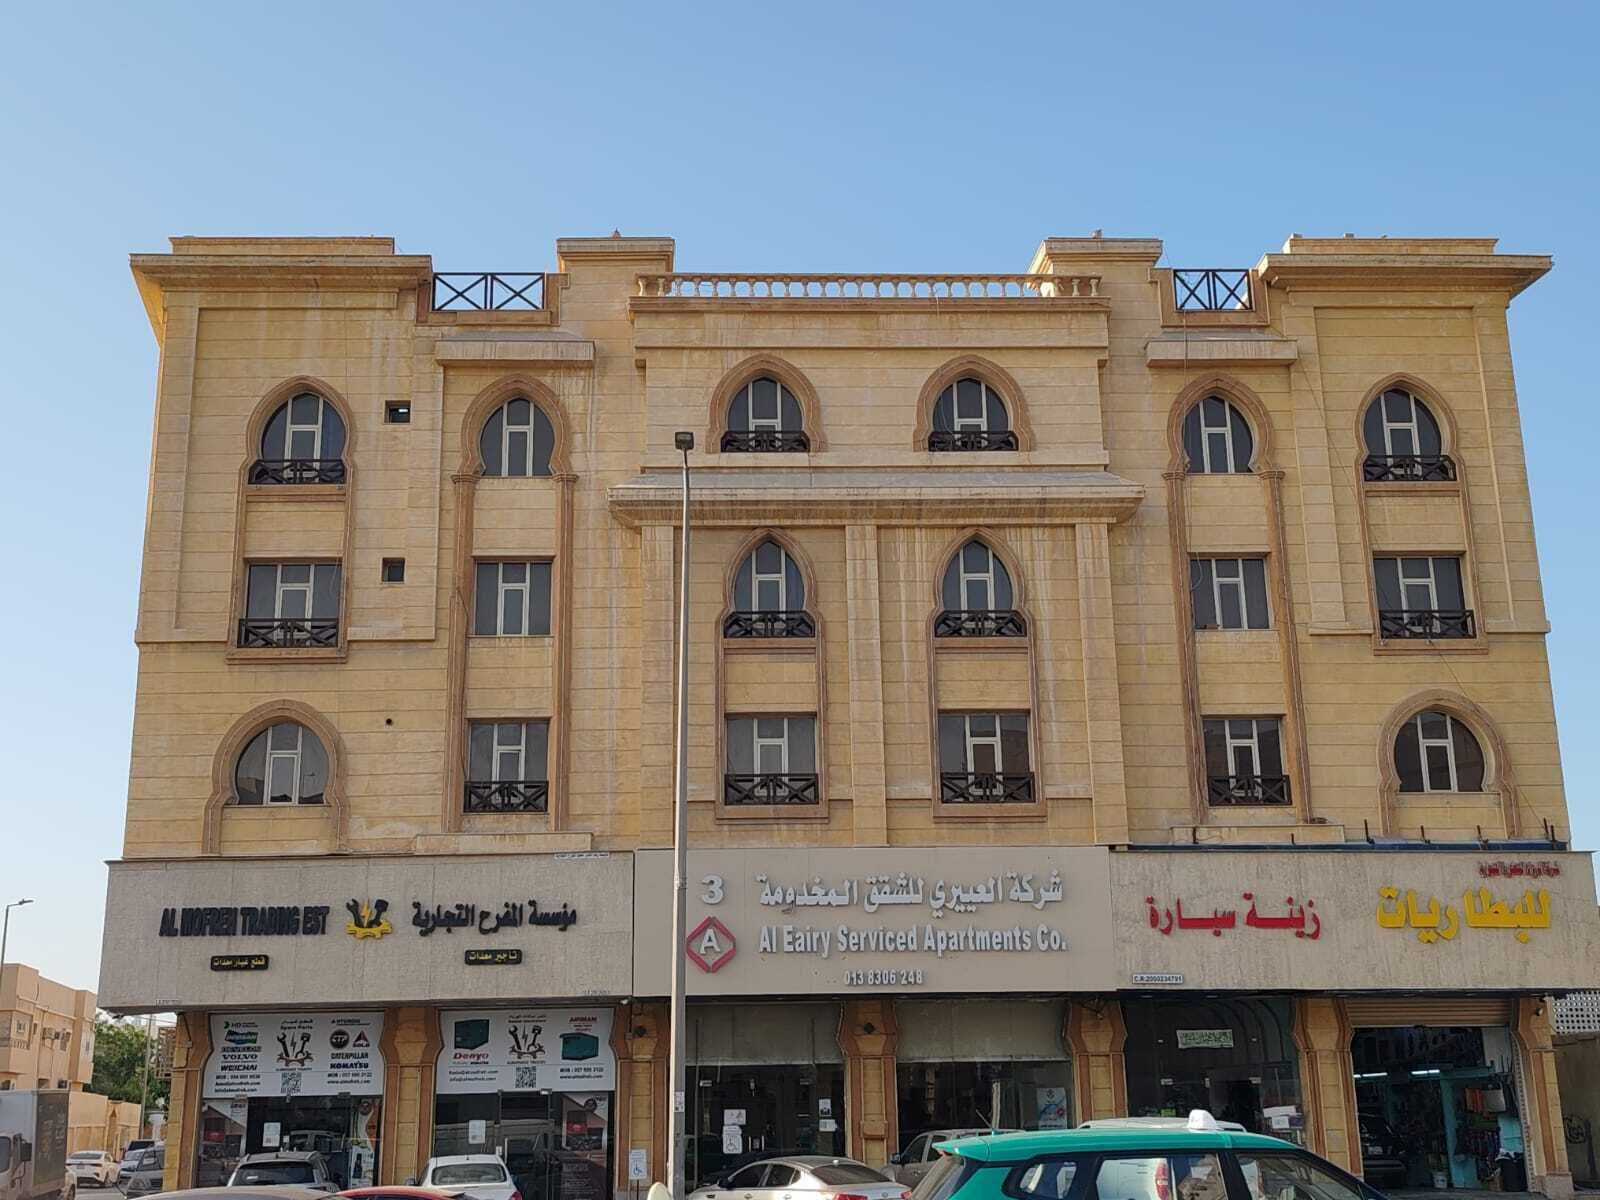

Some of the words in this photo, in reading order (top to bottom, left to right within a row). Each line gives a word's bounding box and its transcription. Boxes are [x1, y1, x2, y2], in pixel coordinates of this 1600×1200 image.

[701, 875, 724, 905] 3
[757, 873, 857, 908] المخدومة
[863, 871, 924, 913] للشقق
[1007, 869, 1063, 910] شركة
[159, 908, 178, 936] AL
[240, 906, 299, 936] TRADING
[302, 906, 330, 935] EST
[412, 901, 475, 937] التجارية
[478, 902, 523, 935] المفرح
[528, 899, 577, 932] مؤسسة
[1145, 896, 1236, 937] سيارة
[1243, 892, 1320, 940] زينة
[701, 928, 721, 954] A
[760, 926, 777, 953] Al
[783, 925, 831, 959] Eairy
[837, 924, 917, 953] Serviced
[924, 923, 1033, 958] Apartments
[1037, 923, 1067, 952] Co.
[844, 970, 864, 985] 013
[867, 969, 896, 985] 8306
[899, 969, 923, 985] 248
[221, 1064, 258, 1072] WEICHAI
[330, 1052, 369, 1060] CATERPILLAR
